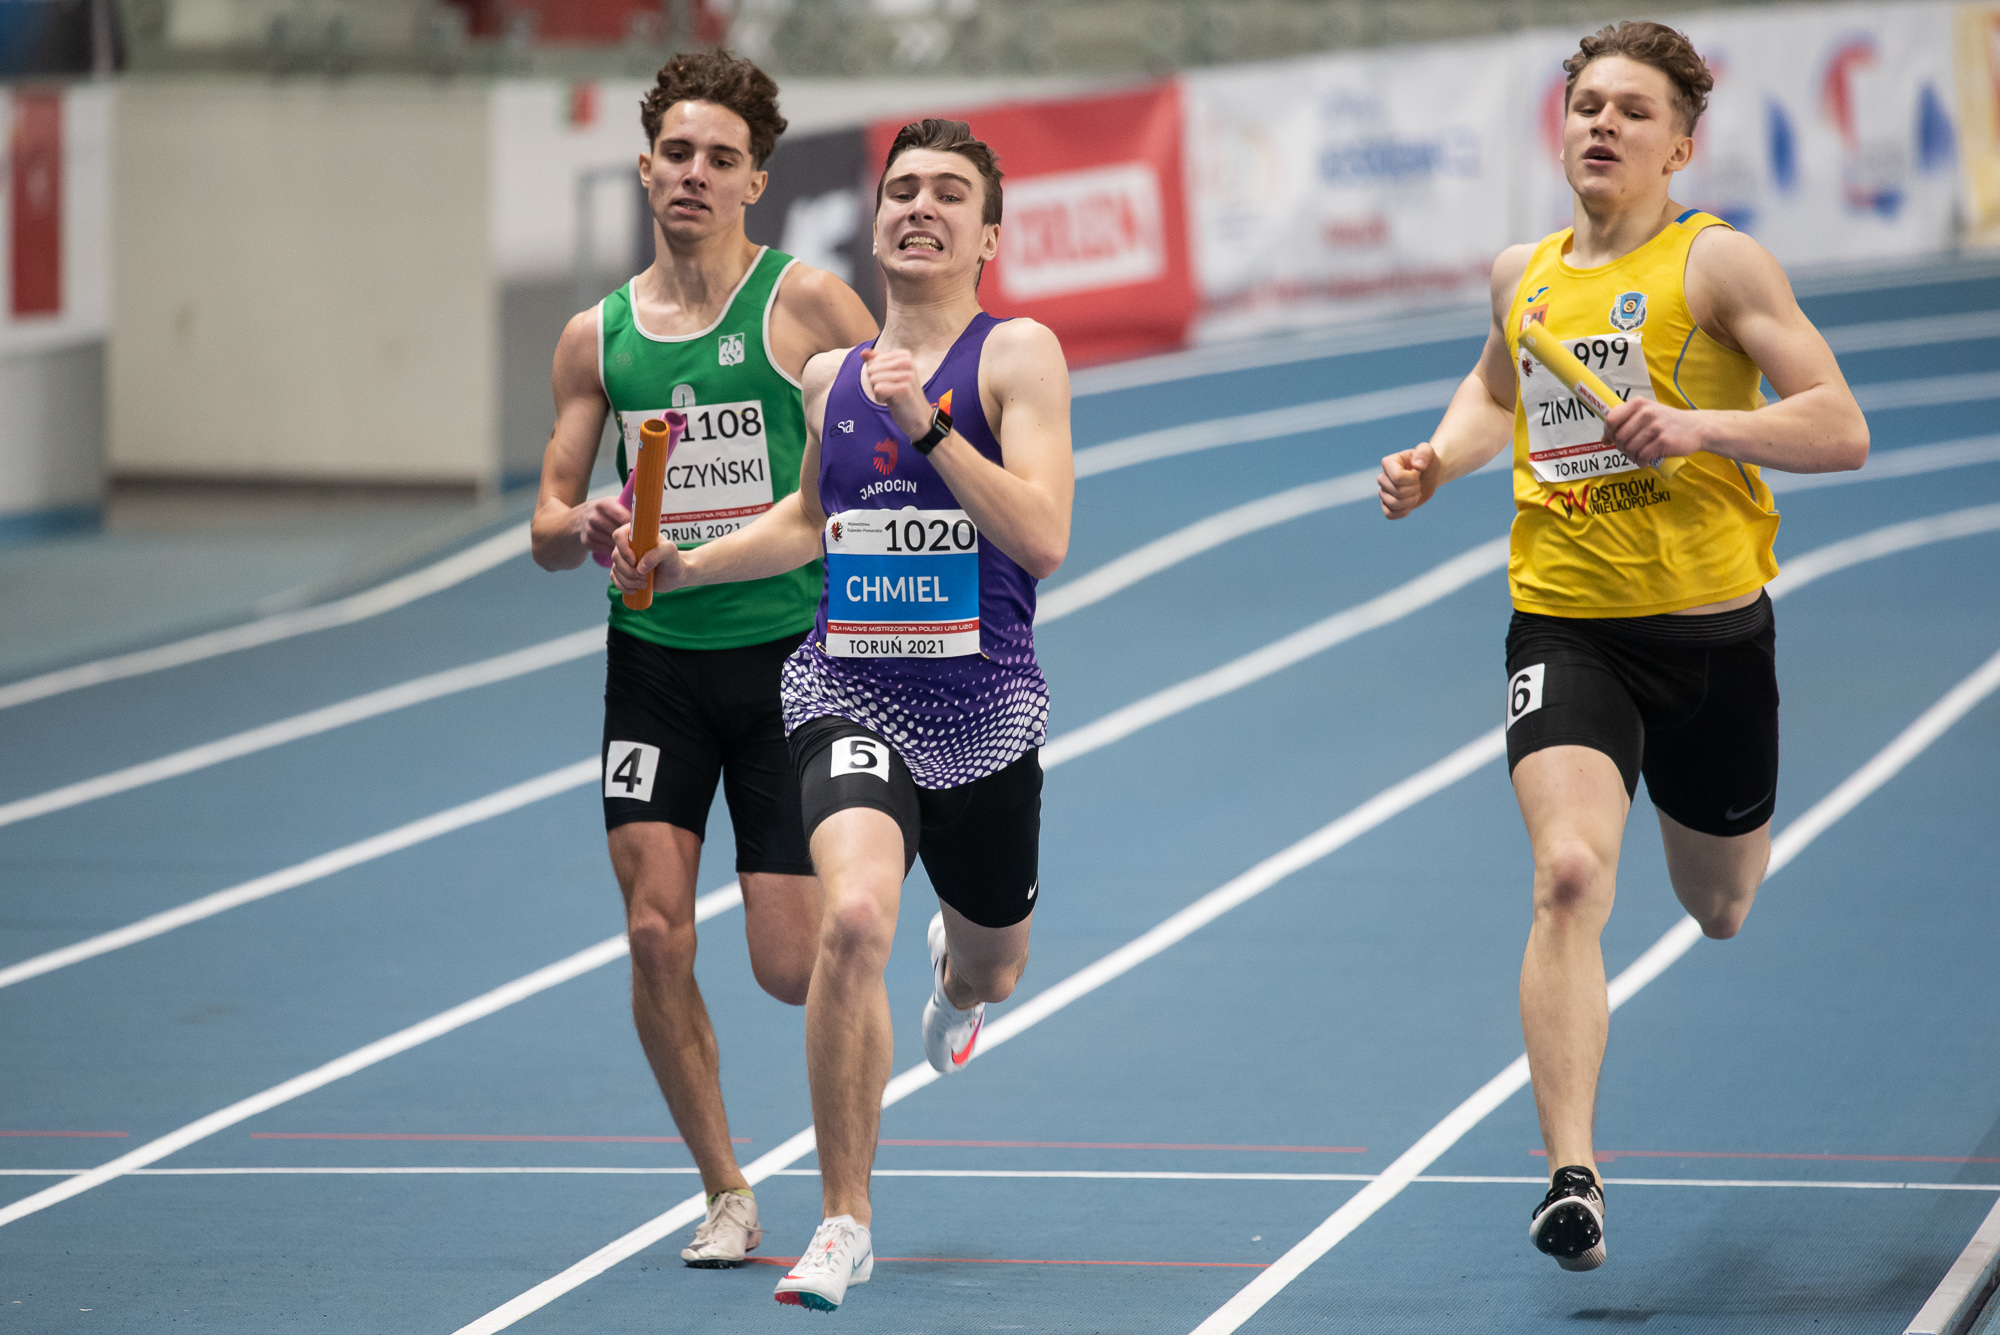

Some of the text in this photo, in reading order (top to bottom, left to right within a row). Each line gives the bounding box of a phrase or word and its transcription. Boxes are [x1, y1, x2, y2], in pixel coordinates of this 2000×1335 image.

[1573, 337, 1629, 370] 999
[680, 407, 762, 442] 1108
[1555, 454, 1599, 477] TORUŃ
[1603, 452, 1635, 470] 202
[859, 479, 917, 500] JAROCIN
[1589, 490, 1671, 515] WIELKOPOLSKI
[1590, 477, 1655, 503] OSTRÓW
[660, 522, 701, 541] ORUŃ
[884, 519, 976, 552] 1020
[846, 575, 949, 602] CHMIEL
[849, 636, 944, 654] TORUŃ 2021
[1511, 673, 1531, 718] 6
[848, 740, 878, 769] 5
[611, 747, 643, 793] 4
